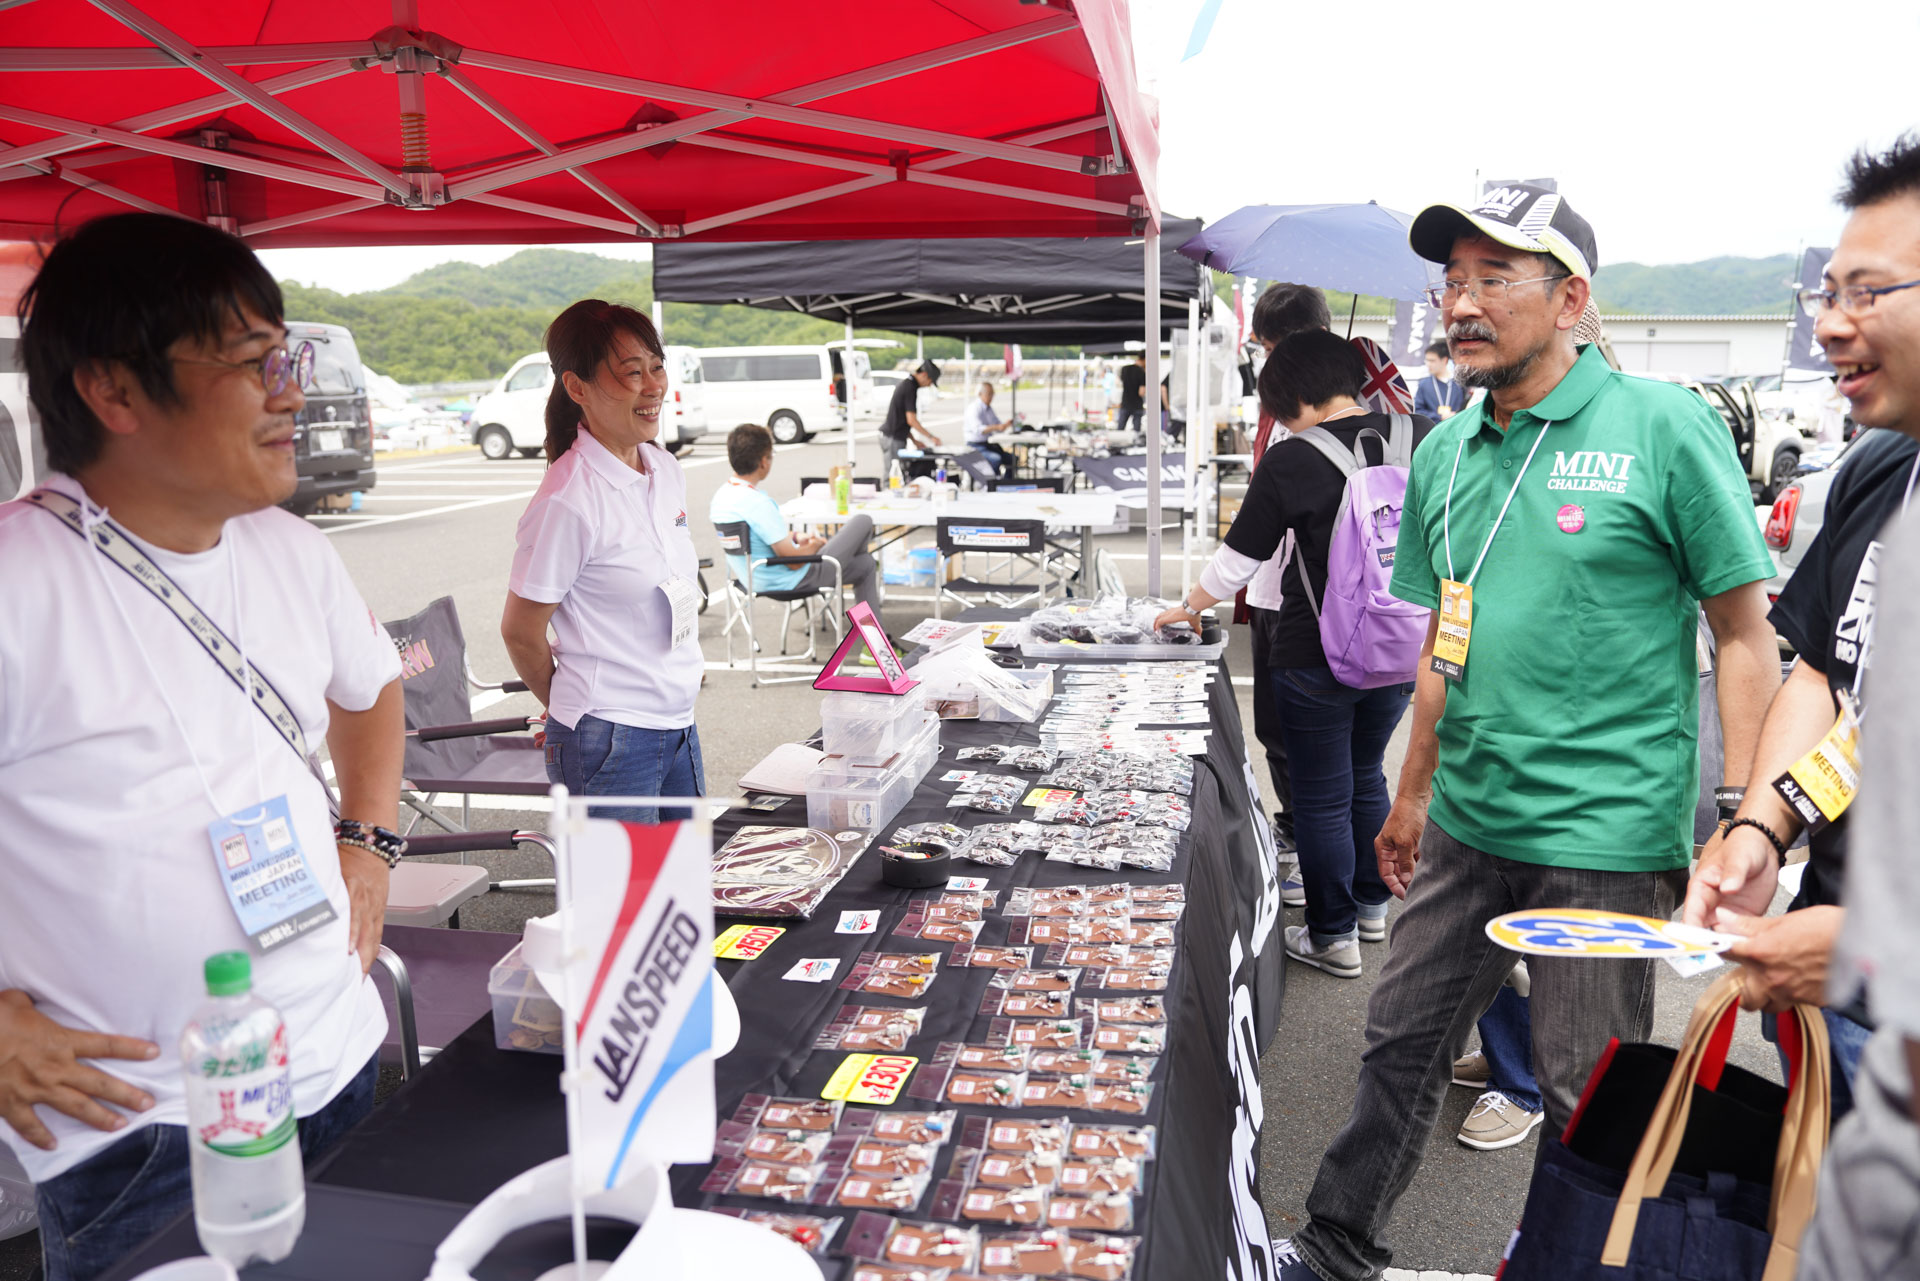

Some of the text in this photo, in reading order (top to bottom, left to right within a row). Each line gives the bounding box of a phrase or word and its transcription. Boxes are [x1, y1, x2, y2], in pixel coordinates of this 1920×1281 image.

[1549, 451, 1636, 481] MINI
[1547, 478, 1628, 494] CHALLENGE
[1439, 630, 1467, 647] MEETING
[1812, 751, 1852, 798] MEETING
[230, 867, 251, 882] MINI
[267, 857, 302, 879] JAPAN
[239, 868, 308, 907] MEETING
[735, 927, 782, 958] ¥1500
[593, 911, 700, 1103] JANSPEED
[860, 1057, 913, 1101] ¥1300
